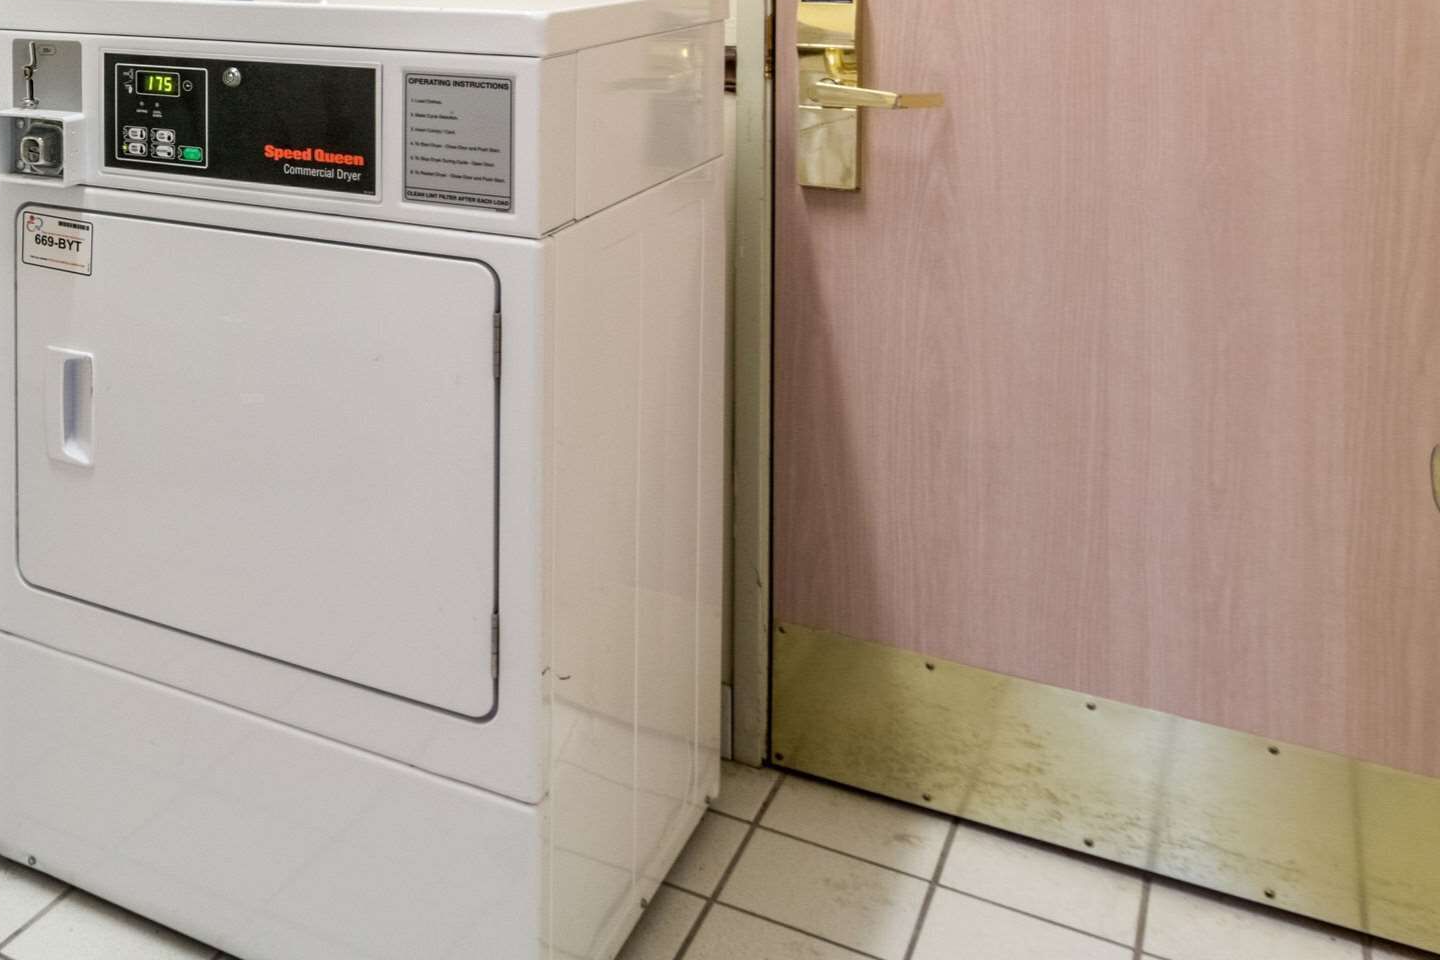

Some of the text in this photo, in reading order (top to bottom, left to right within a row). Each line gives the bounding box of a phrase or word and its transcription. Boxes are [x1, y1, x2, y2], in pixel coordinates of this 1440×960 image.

[148, 75, 173, 92] 175
[408, 77, 509, 91] OPERATING INSTRUCTIONS
[264, 144, 364, 166] Speed Queen
[283, 163, 361, 182] Commercial Dryer
[34, 234, 82, 252] 669-BYT
